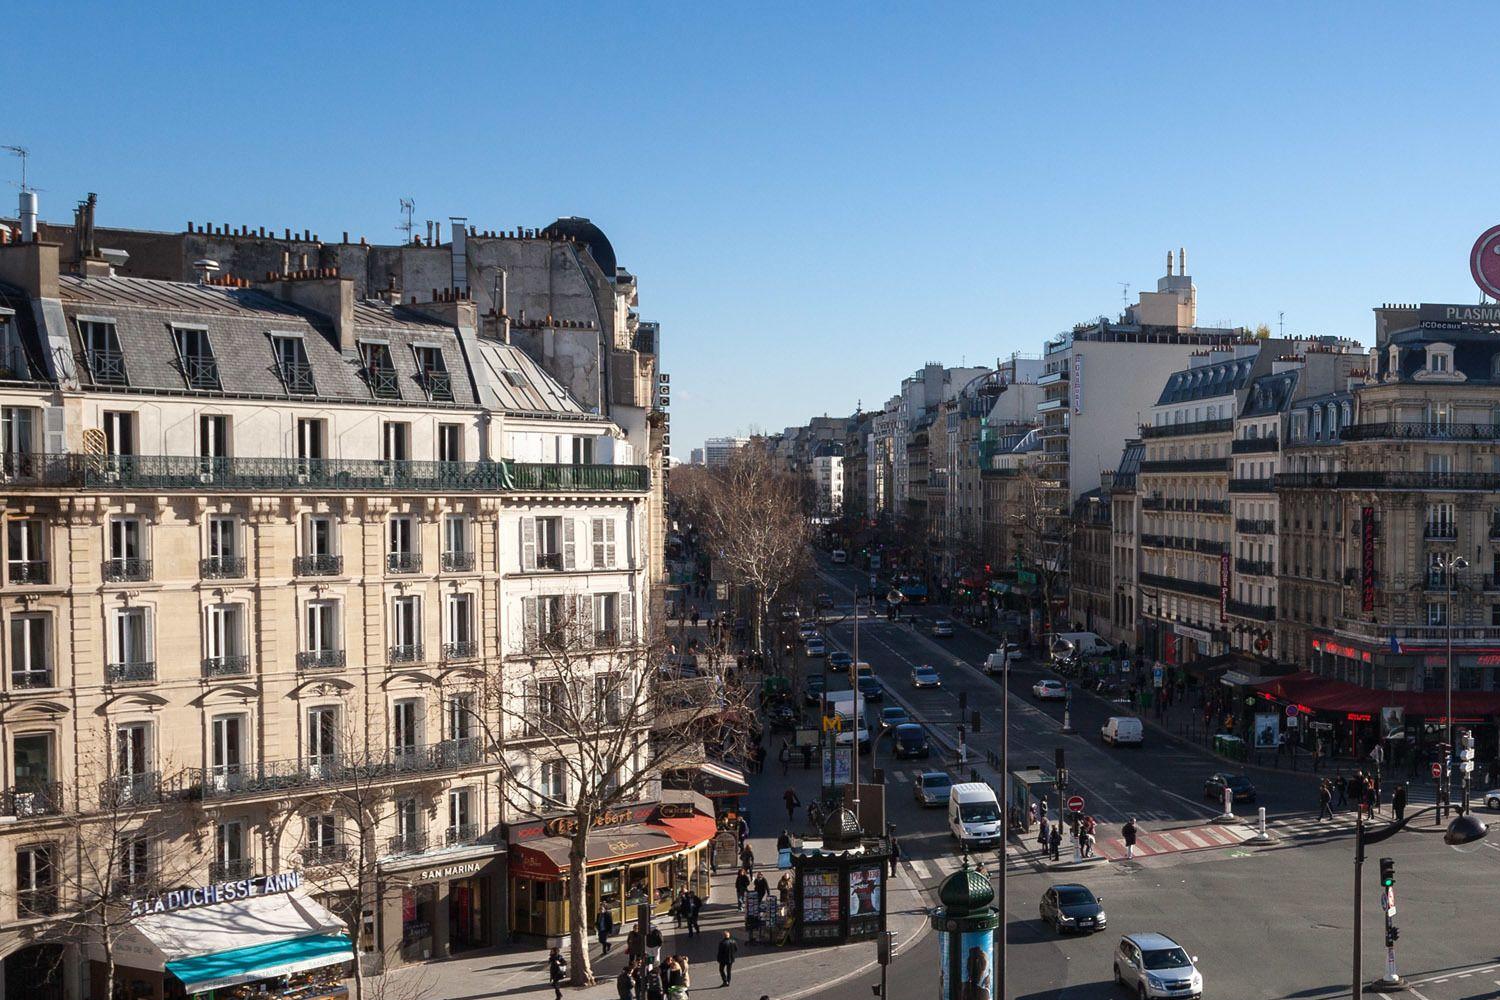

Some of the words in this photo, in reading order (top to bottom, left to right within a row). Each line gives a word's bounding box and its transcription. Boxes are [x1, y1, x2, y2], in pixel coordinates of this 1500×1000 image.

[1420, 321, 1462, 330] JCDecaux
[822, 715, 843, 734] M
[421, 869, 442, 880] SAN
[444, 863, 481, 877] MARINA
[131, 900, 142, 916] A
[143, 898, 165, 914] LA
[167, 879, 257, 910] DUCHESSE
